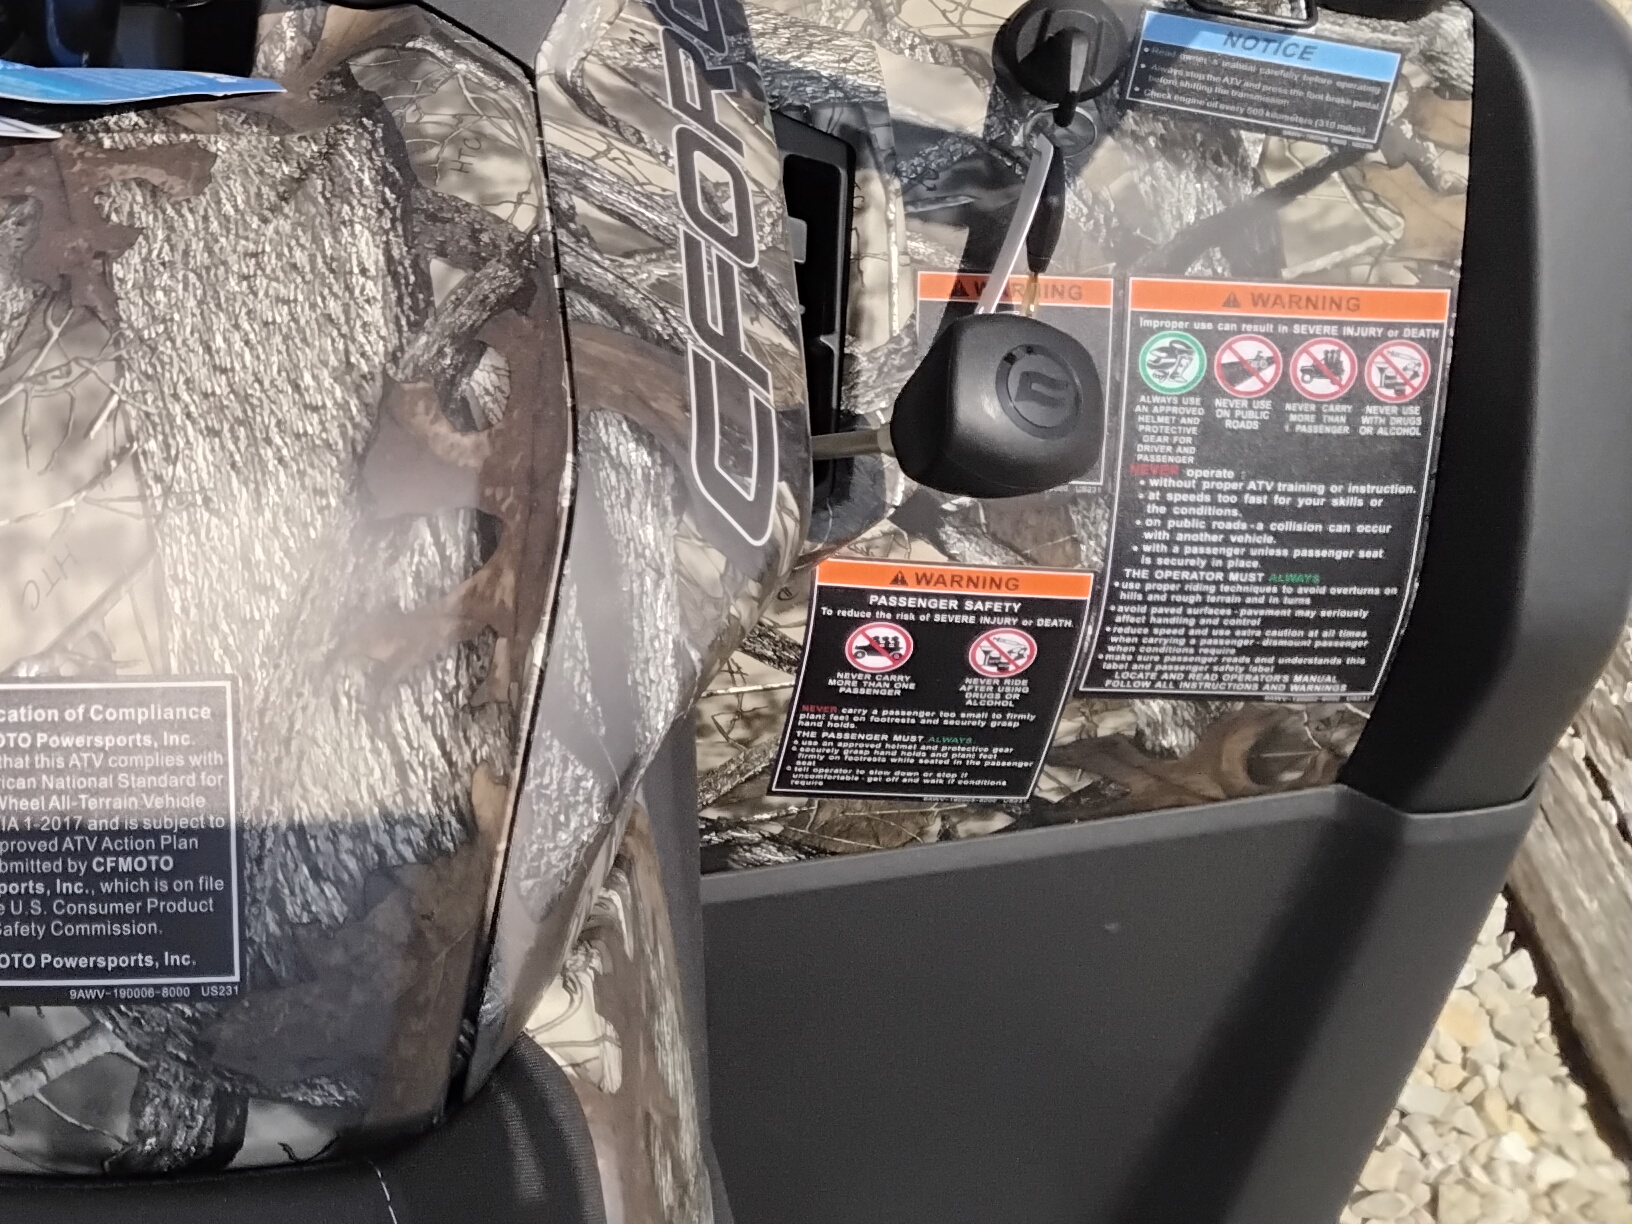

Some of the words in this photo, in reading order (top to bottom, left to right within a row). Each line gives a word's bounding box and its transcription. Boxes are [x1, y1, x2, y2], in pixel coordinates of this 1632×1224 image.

[1221, 31, 1318, 62] NOTICE
[1251, 293, 1361, 312] WARNING
[1141, 318, 1189, 332] Improper
[1193, 322, 1214, 330] use
[1217, 323, 1238, 331] can
[1241, 324, 1274, 333] result
[1279, 325, 1289, 334] in
[1293, 324, 1339, 336] SEVERE
[1343, 327, 1384, 337] INJURY
[1387, 330, 1400, 338] or
[1403, 328, 1440, 339] DEATH
[1141, 395, 1178, 405] ALWAYS
[1183, 397, 1201, 406] USE
[1215, 399, 1248, 410] NEVER
[1253, 400, 1272, 410] USE
[1285, 403, 1316, 412] NEVER
[1323, 405, 1353, 413] CARRY
[1135, 405, 1149, 413] AN
[1153, 406, 1205, 416] APPROVED
[1215, 409, 1231, 421] ON
[1235, 410, 1270, 420] PUBLIC
[1367, 406, 1398, 415] NEVER
[1403, 406, 1421, 416] USE
[1139, 415, 1176, 424] HELMET
[1181, 417, 1201, 425] AND
[1225, 420, 1259, 430] ROADS
[1289, 414, 1316, 423] MORE
[1323, 415, 1347, 424] THAN
[1361, 416, 1386, 425] WITH
[1391, 417, 1422, 426] DRUGS
[1139, 425, 1198, 435] PROTECTIVE
[1285, 424, 1290, 433] 1
[1295, 425, 1350, 434] PASSENGER
[1359, 426, 1374, 436] OR
[1377, 427, 1421, 436] ALCOHOL
[1141, 435, 1170, 445] GEAR
[1173, 436, 1193, 445] FOR
[1137, 445, 1173, 453] DRIVER
[1177, 446, 1196, 455] AND
[1137, 454, 1194, 464] PASSENGER
[1186, 469, 1235, 481] operate
[1149, 478, 1197, 488] without
[1203, 481, 1244, 491] proper
[1247, 481, 1275, 491] ATV
[1277, 483, 1325, 495] training
[1331, 485, 1344, 494] or
[1349, 484, 1416, 495] instruction.
[915, 573, 1019, 591] WARNING
[1125, 569, 1150, 579] THE
[1155, 570, 1224, 581] OPERATOR
[1229, 572, 1265, 582] MUST
[1269, 574, 1319, 583] ALWAYS
[869, 595, 958, 610] PASSENGER
[965, 601, 1021, 613] SAFETY
[821, 607, 834, 616] To
[837, 609, 872, 618] reduce
[875, 611, 892, 620] the
[897, 613, 916, 621] risk
[919, 613, 931, 622] of
[935, 614, 976, 624] SEVERE
[981, 616, 1019, 626] INJURY
[1037, 617, 1074, 628] DEATH.
[65, 705, 85, 722] of
[91, 705, 211, 724] Compliance
[37, 733, 157, 750] Powersports,
[164, 731, 197, 747] Inc.
[35, 754, 65, 769] this
[69, 753, 104, 770] ATV
[109, 753, 185, 770] complies
[189, 751, 223, 766] with
[42, 774, 113, 790] National
[119, 772, 196, 789] Standard
[200, 771, 224, 787] for
[49, 795, 138, 811] All-Terrain
[143, 794, 206, 809] Vehicle
[24, 815, 83, 832] 1-2017
[87, 814, 119, 831] and
[125, 815, 138, 830] is
[143, 812, 205, 833] subject
[209, 812, 225, 829] to
[63, 836, 98, 852] ATV
[103, 836, 156, 851] Action
[161, 835, 199, 850] Plan
[67, 858, 88, 877] by
[93, 856, 174, 873] CFMOTO
[57, 879, 95, 896] Inc.,
[101, 878, 150, 893] which
[155, 878, 169, 893] is
[173, 880, 194, 892] on
[199, 876, 224, 891] file
[11, 900, 47, 916] U.S.
[53, 900, 142, 915] Consumer
[147, 898, 214, 913] Product
[50, 920, 163, 936] Commission.
[41, 954, 159, 971] Powersports,
[165, 952, 196, 966] Inc.
